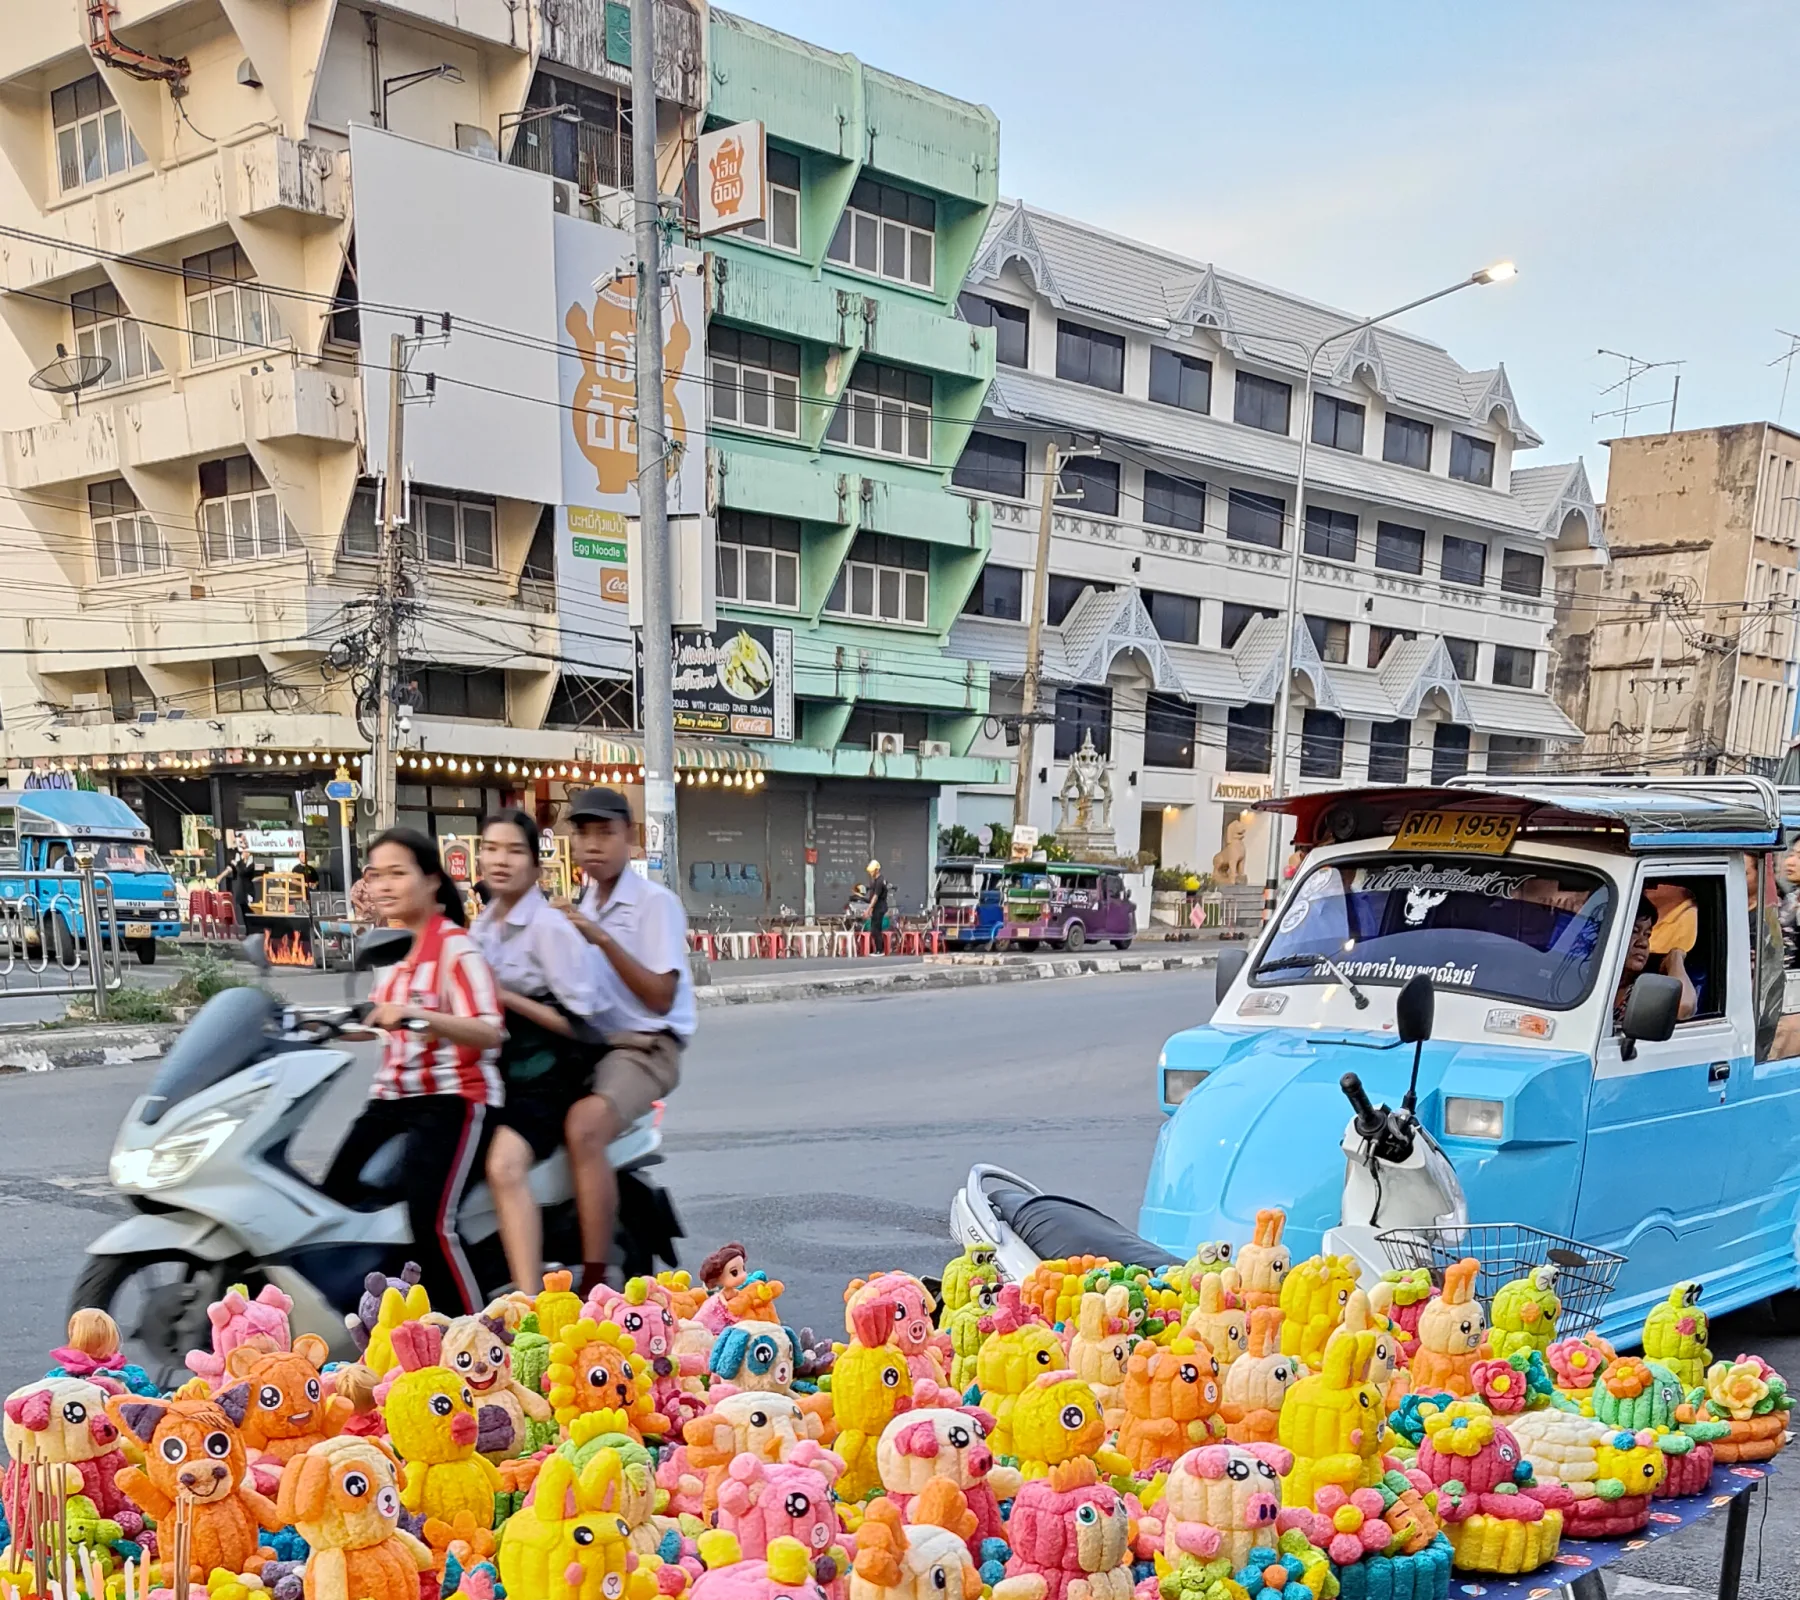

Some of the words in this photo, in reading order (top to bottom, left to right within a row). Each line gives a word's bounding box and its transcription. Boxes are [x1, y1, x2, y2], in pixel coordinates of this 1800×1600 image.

[716, 158, 738, 179] เฮีย
[714, 180, 741, 205] อ้อง
[573, 541, 590, 556] Egg
[592, 543, 621, 558] Noodle
[691, 700, 707, 710] WITH
[708, 702, 730, 712] GRILLED
[732, 703, 748, 713] RIVER
[750, 705, 773, 715] PRAWN
[1215, 782, 1262, 799] AYOTHAYA
[1453, 814, 1517, 838] 1955
